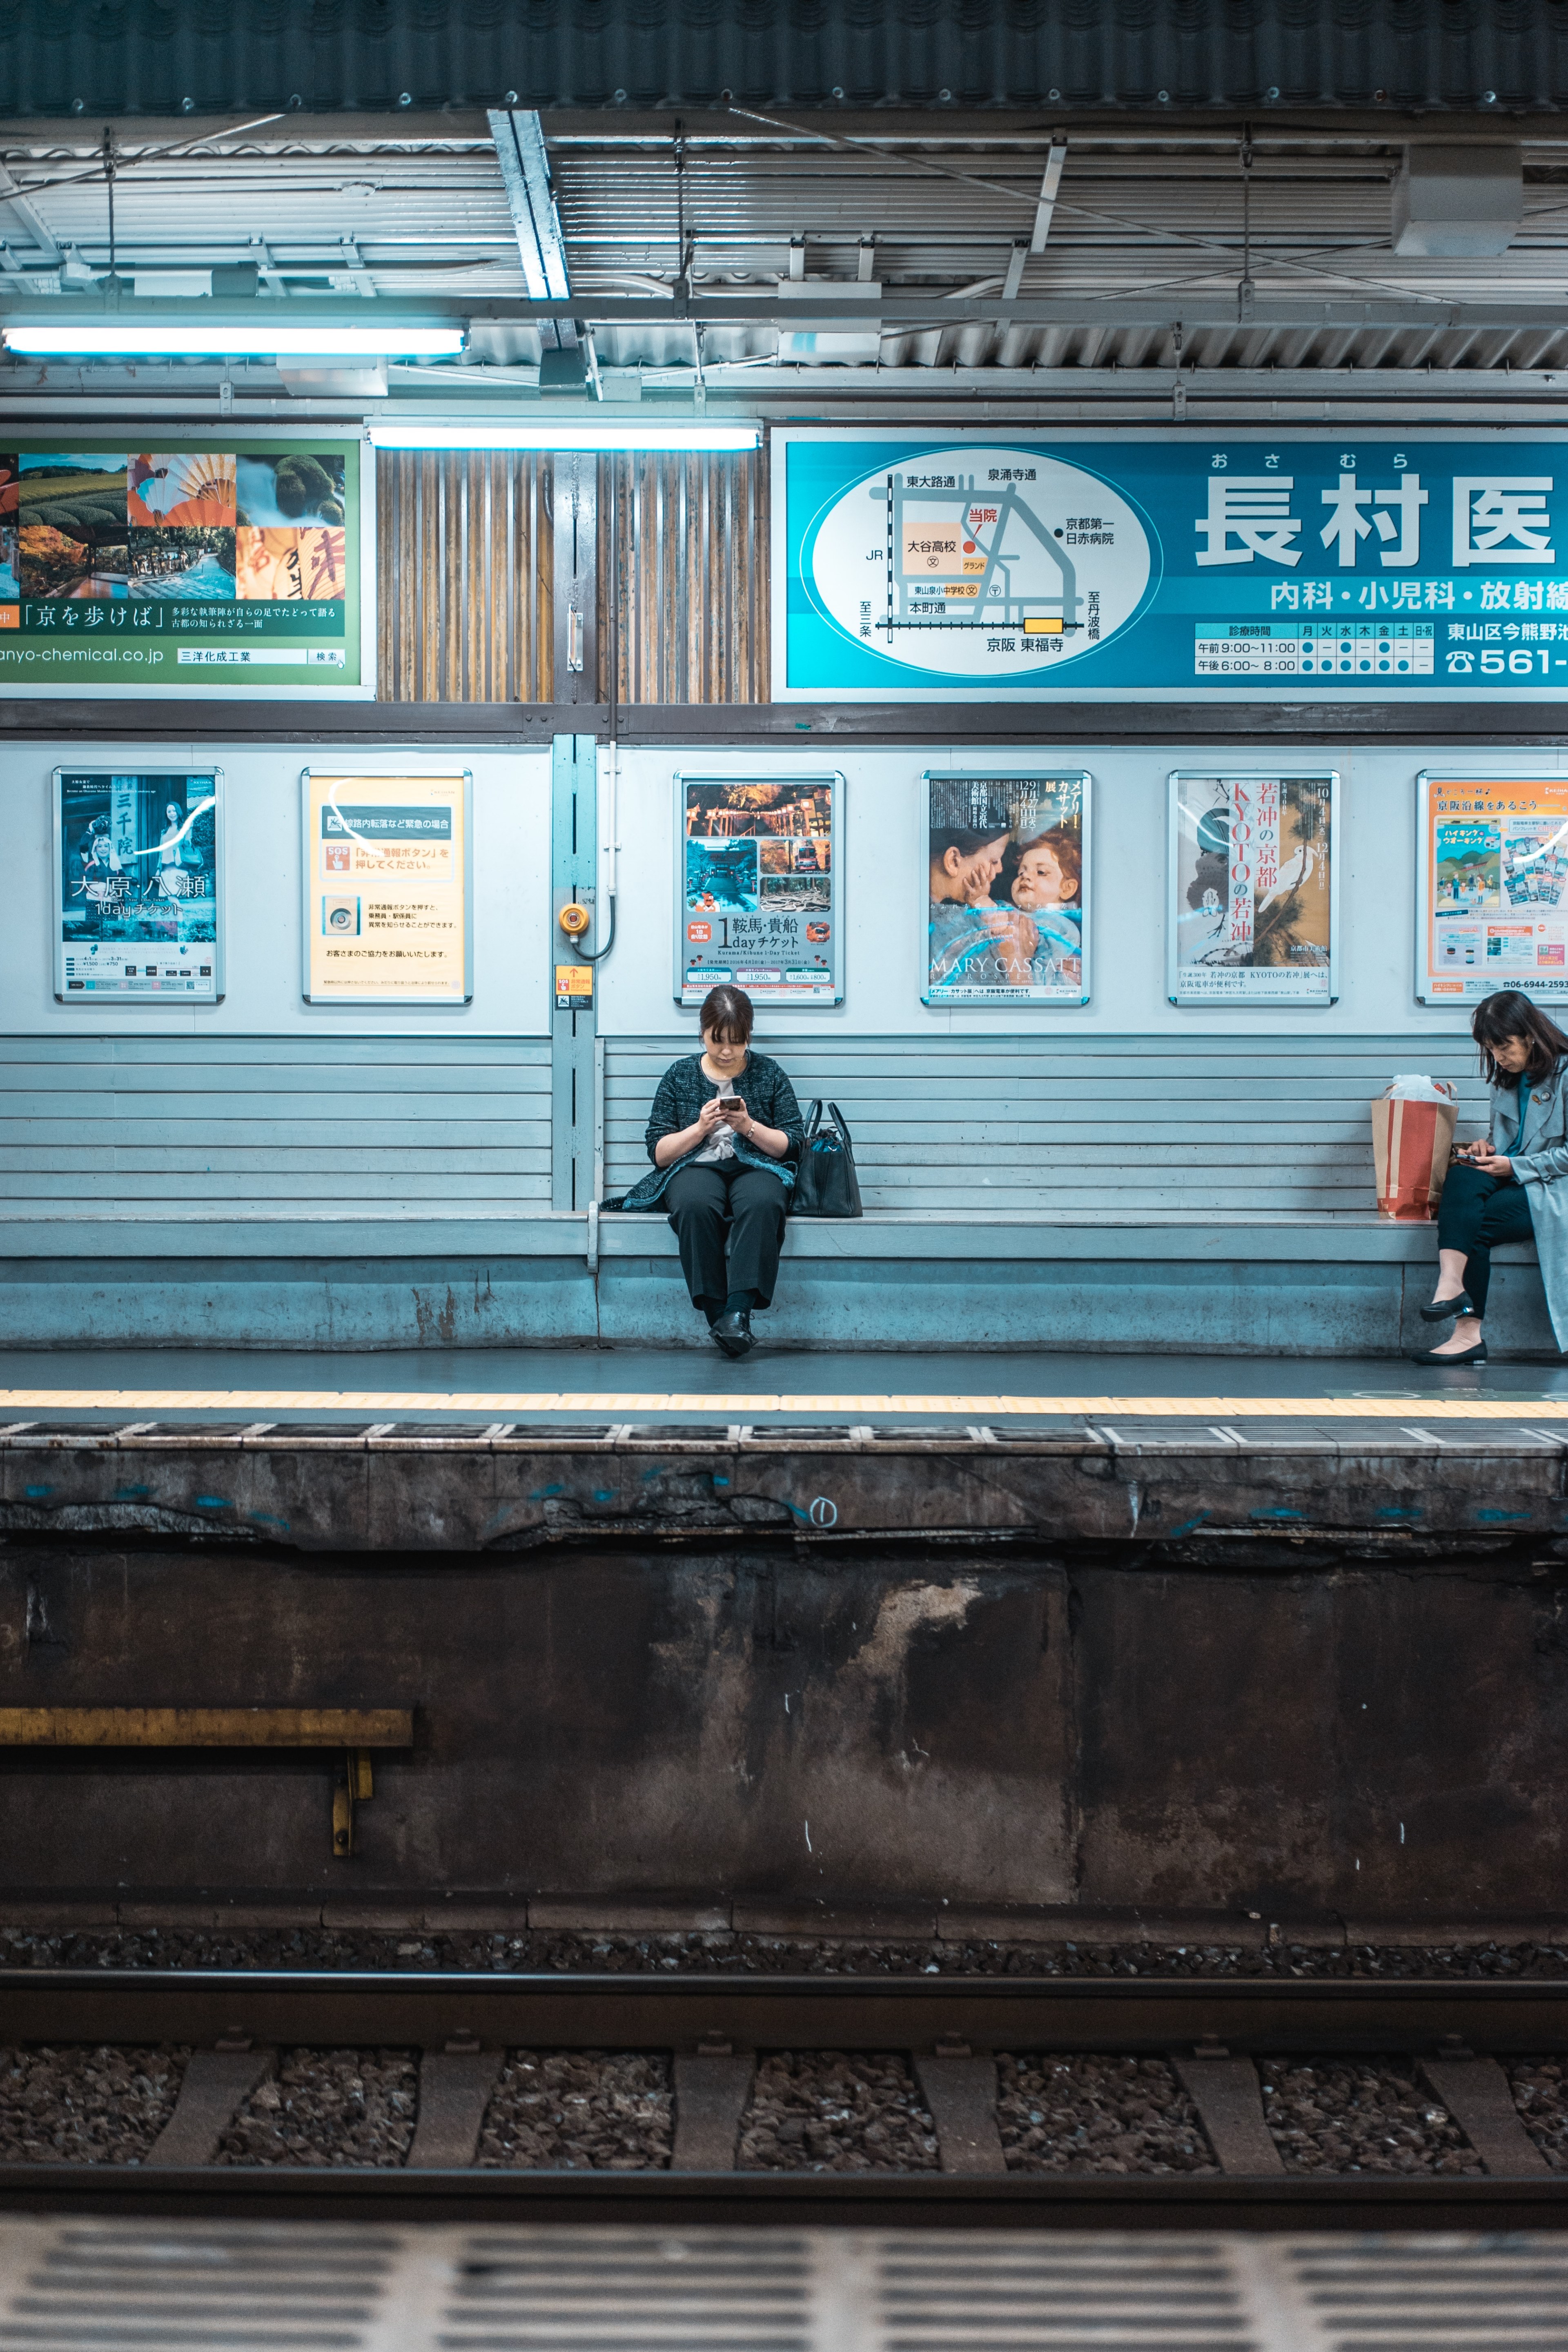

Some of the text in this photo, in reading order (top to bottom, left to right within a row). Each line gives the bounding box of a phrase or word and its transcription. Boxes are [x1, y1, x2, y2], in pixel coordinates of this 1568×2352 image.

[988, 469, 1036, 481] 泉涌寺通
[907, 476, 956, 488] 東大路通
[969, 508, 997, 522] 当院
[1194, 473, 1556, 567] 長村医
[1066, 518, 1114, 530] 京都第一
[1066, 532, 1114, 545] 日赤病院
[908, 541, 956, 552] 大谷高校
[866, 550, 883, 560] JR
[172, 607, 335, 617] 多彩な執筆陣が自らの足でたどって語る
[910, 602, 946, 614] 本町通
[26, 605, 163, 628] 「京を歩けば」
[860, 601, 871, 637] 至三条
[1088, 591, 1100, 640] 至丹波橋
[172, 619, 263, 628] 古都の知られざる一面
[1229, 626, 1271, 636] 診療時間
[1303, 626, 1312, 636] 月
[1321, 626, 1332, 636] 火
[1341, 626, 1351, 636] 水
[1359, 626, 1370, 636] 木
[1379, 626, 1390, 636] 金
[1398, 626, 1408, 636] 土
[987, 638, 1063, 652] 京阪 東福寺
[181, 651, 251, 662] 三洋化成工業
[1045, 781, 1056, 793] 展
[979, 781, 988, 829] 京都国立近代
[116, 793, 134, 856] 三千院
[1256, 783, 1278, 887] 若冲の京都
[356, 860, 430, 869] 押してください。
[71, 875, 205, 898] 大原・八瀬
[732, 918, 799, 934] 鞍馬・貴船
[326, 950, 448, 958] お客さまのご協力をお願いいたします。
[930, 958, 1081, 972] MARY CASSATT
